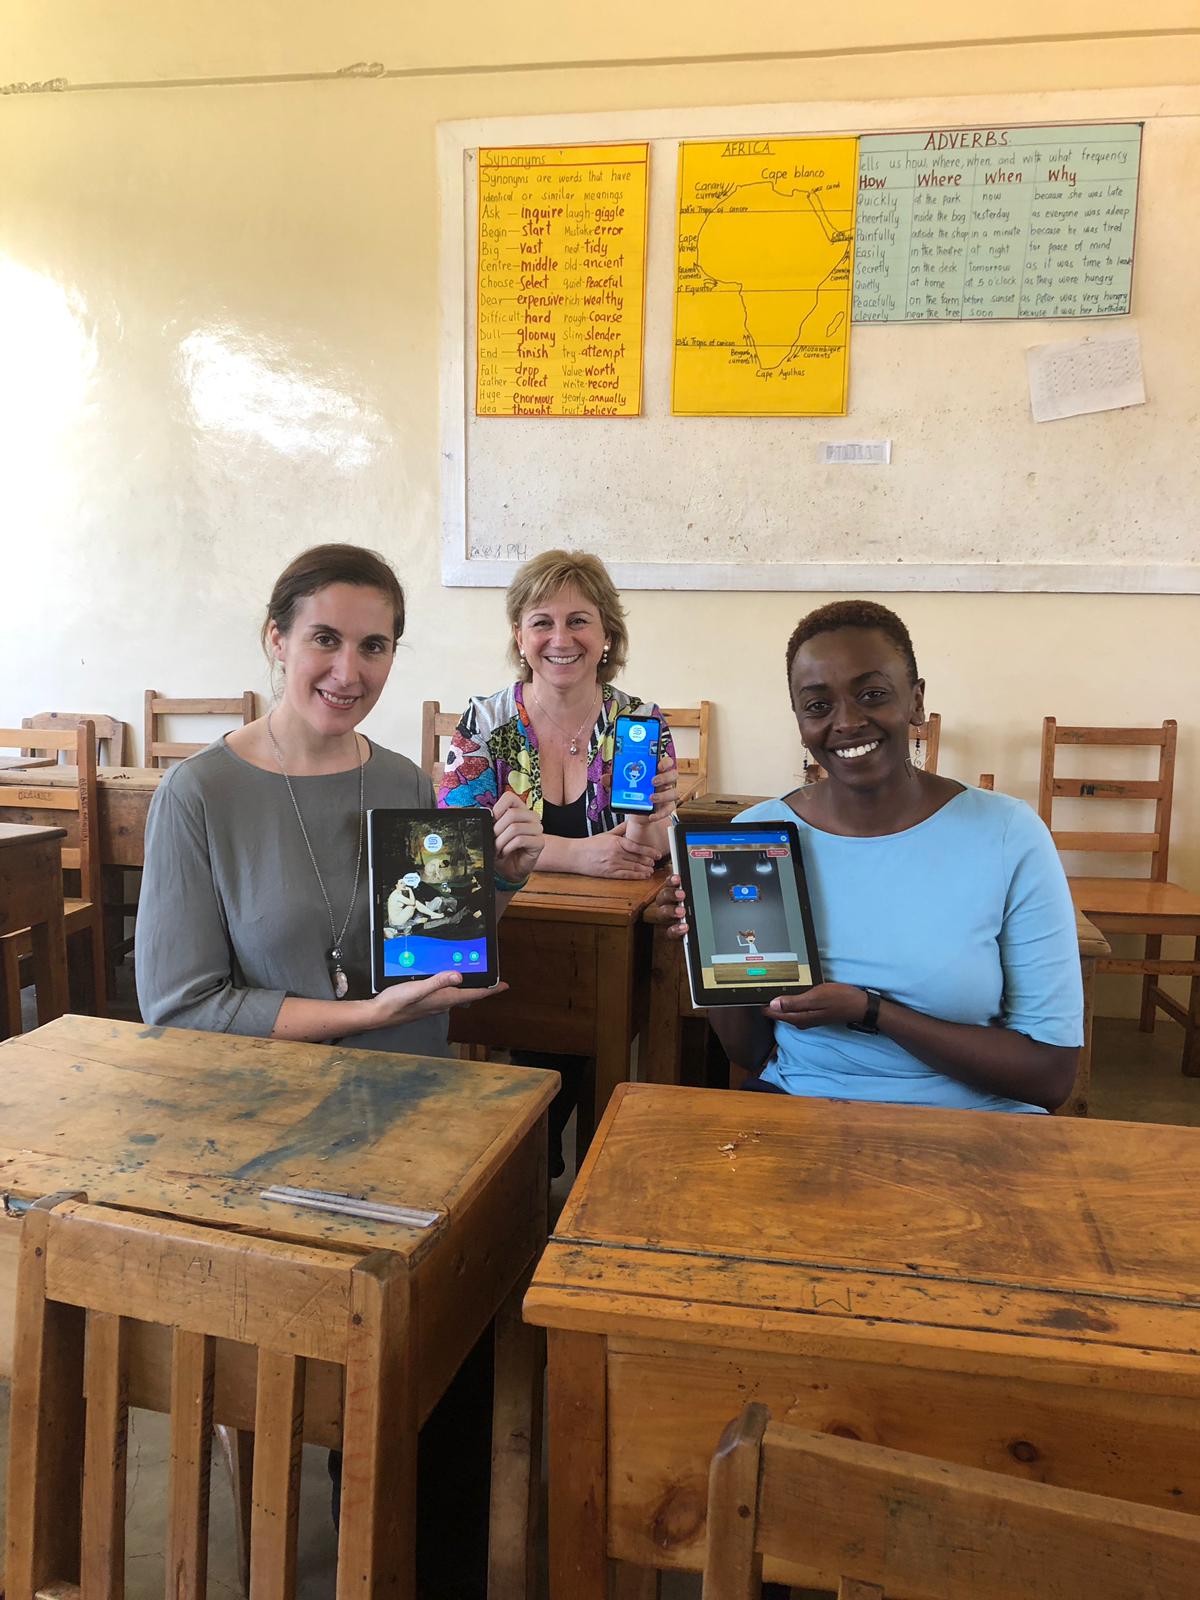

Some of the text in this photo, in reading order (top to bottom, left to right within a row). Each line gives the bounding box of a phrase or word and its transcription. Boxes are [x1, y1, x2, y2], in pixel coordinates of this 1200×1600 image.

[722, 141, 770, 156] AFRICA
[924, 131, 1008, 151] ADVERBS
[486, 151, 546, 170] Synonyms
[890, 159, 900, 169] us
[998, 152, 1016, 164] and
[1049, 148, 1072, 162] what
[1082, 147, 1128, 165] frequency
[481, 168, 631, 188] Synonyms are words that have
[761, 166, 824, 184] Cape blanco
[860, 174, 887, 190] How
[918, 169, 962, 186] Where
[695, 182, 724, 192] Canary
[1034, 188, 1102, 200] because she was
[483, 189, 623, 204] identical or similar meanings
[926, 194, 936, 204] the
[943, 195, 961, 205] park
[482, 205, 563, 224] Ask inquire
[565, 205, 625, 222] laugh giggle
[937, 208, 966, 224] the bag
[1045, 210, 1078, 221] everyone
[482, 220, 551, 242] Begin start
[594, 224, 624, 235] error
[1031, 222, 1122, 235] because he was tired
[679, 234, 697, 245] Cape
[856, 228, 895, 246] Painfully
[939, 228, 948, 238] the
[482, 242, 499, 260] Big
[584, 238, 608, 257] tidy
[856, 245, 886, 261] Easily
[922, 244, 933, 256] the
[971, 245, 980, 254] at
[989, 244, 1009, 258] night
[1074, 241, 1083, 252] of
[1090, 238, 1112, 249] mind
[481, 255, 558, 271] Centre middle
[564, 255, 624, 271] old ancient
[856, 261, 889, 277] Secretly
[911, 265, 920, 273] on
[923, 262, 935, 272] the
[939, 262, 957, 273] desk
[1026, 262, 1037, 270] as
[1044, 258, 1051, 268] it
[1083, 256, 1101, 268] time
[1106, 256, 1112, 264] to
[855, 280, 880, 292] Quietly
[925, 279, 945, 289] home
[965, 278, 974, 287] at
[1036, 276, 1053, 287] they
[1085, 273, 1113, 285] hungry
[481, 294, 564, 309] Dear expensive
[564, 290, 624, 310] rich wealthy
[854, 293, 984, 310] Peacefully on the farm before
[1104, 291, 1128, 304] hungry
[926, 309, 938, 318] the
[946, 308, 960, 316] tree
[970, 308, 993, 317] soon
[1053, 306, 1058, 314] it
[1080, 305, 1092, 314] her
[1097, 303, 1126, 313] birthday
[481, 310, 551, 323] Difficult hard
[564, 312, 586, 326] rough
[480, 328, 556, 347] Dull gloomy
[563, 326, 621, 341] slim slender
[481, 345, 548, 359] End finish
[562, 343, 625, 362] try attempt
[801, 345, 840, 353] Mozambique
[481, 362, 539, 380] Fall drop
[756, 368, 805, 382] Cape Agulhas
[480, 376, 507, 386] Gather
[588, 377, 619, 389] record
[480, 391, 554, 404] Huge enormous
[562, 393, 626, 406] yearly annually
[512, 405, 551, 415] thought
[583, 405, 618, 415] believe
